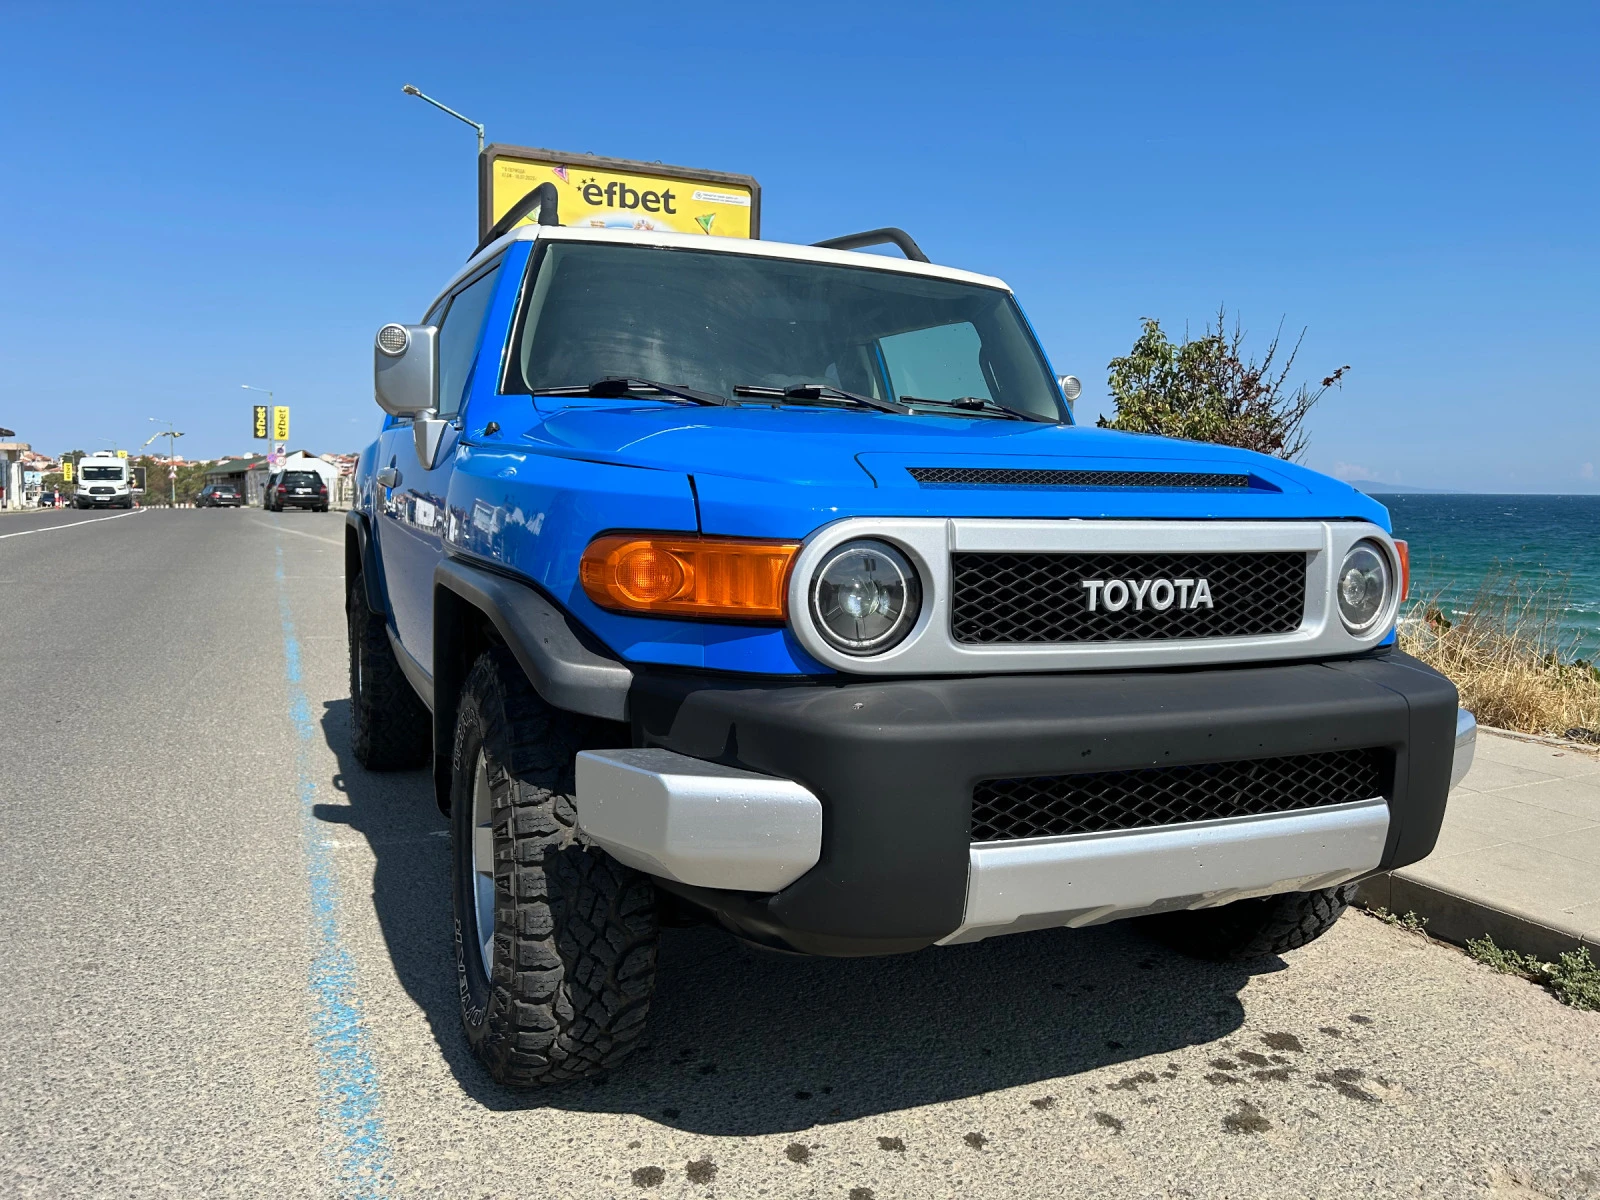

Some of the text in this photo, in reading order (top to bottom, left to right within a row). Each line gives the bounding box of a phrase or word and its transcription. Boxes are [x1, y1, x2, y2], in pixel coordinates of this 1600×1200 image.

[582, 181, 677, 215] efbet
[256, 406, 266, 438] efbet
[277, 408, 287, 438] efbet
[1081, 578, 1214, 612] TOYOTA
